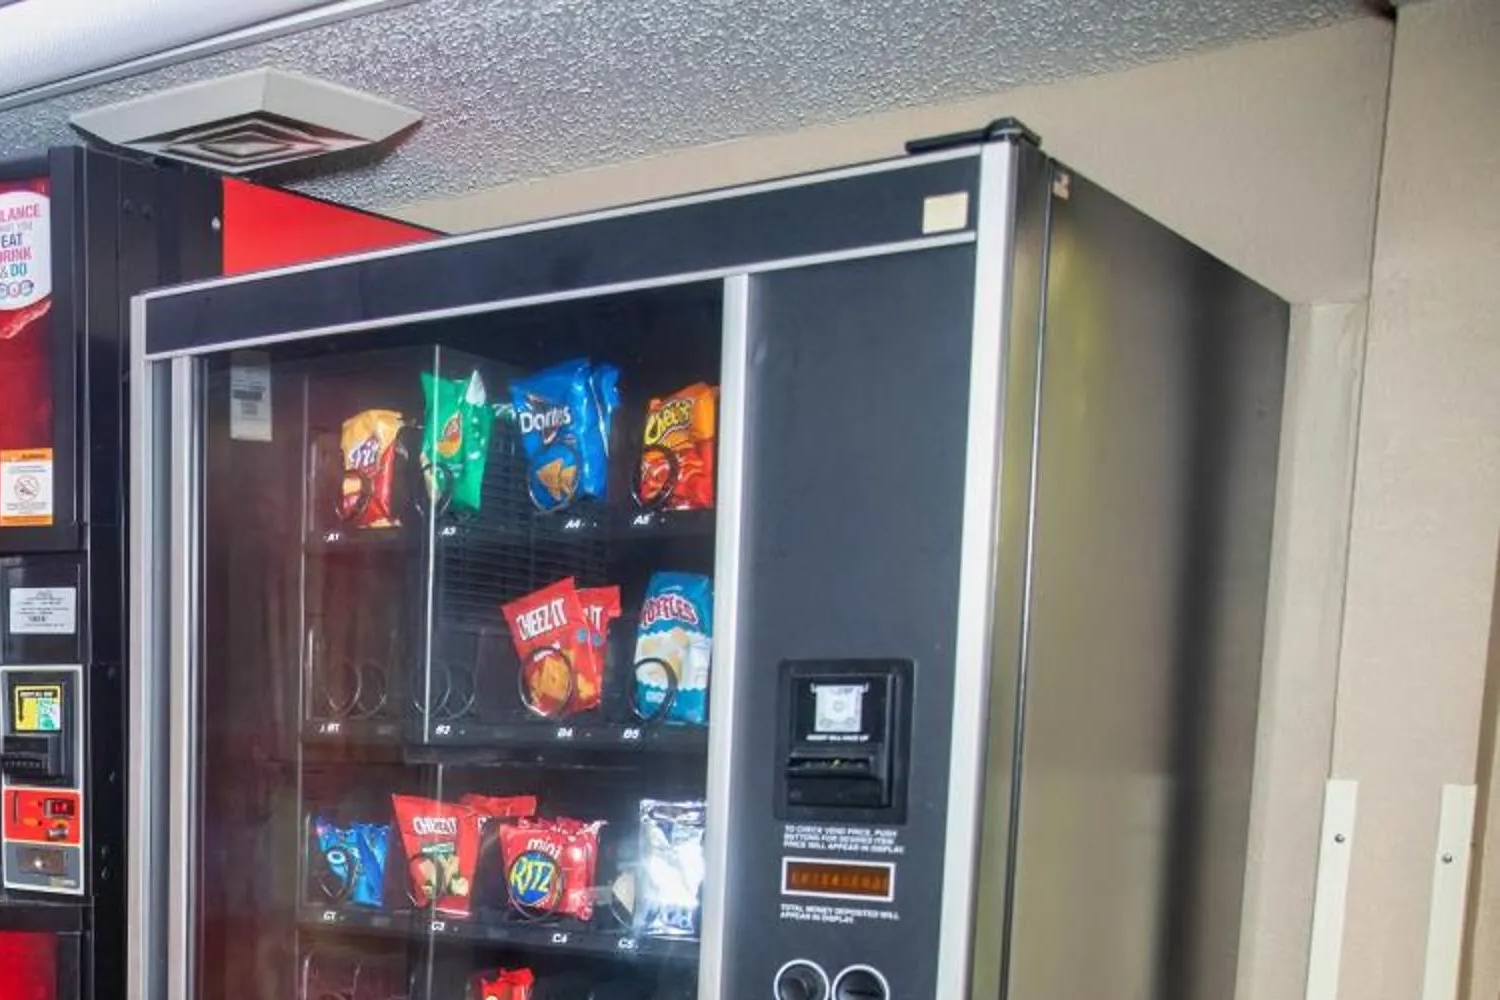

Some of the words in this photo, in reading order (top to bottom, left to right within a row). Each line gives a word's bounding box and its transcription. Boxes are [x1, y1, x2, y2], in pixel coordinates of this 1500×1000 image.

[1, 233, 23, 248] EAT
[10, 263, 28, 277] DO
[527, 836, 563, 859] mini
[511, 857, 554, 896] RITZ
